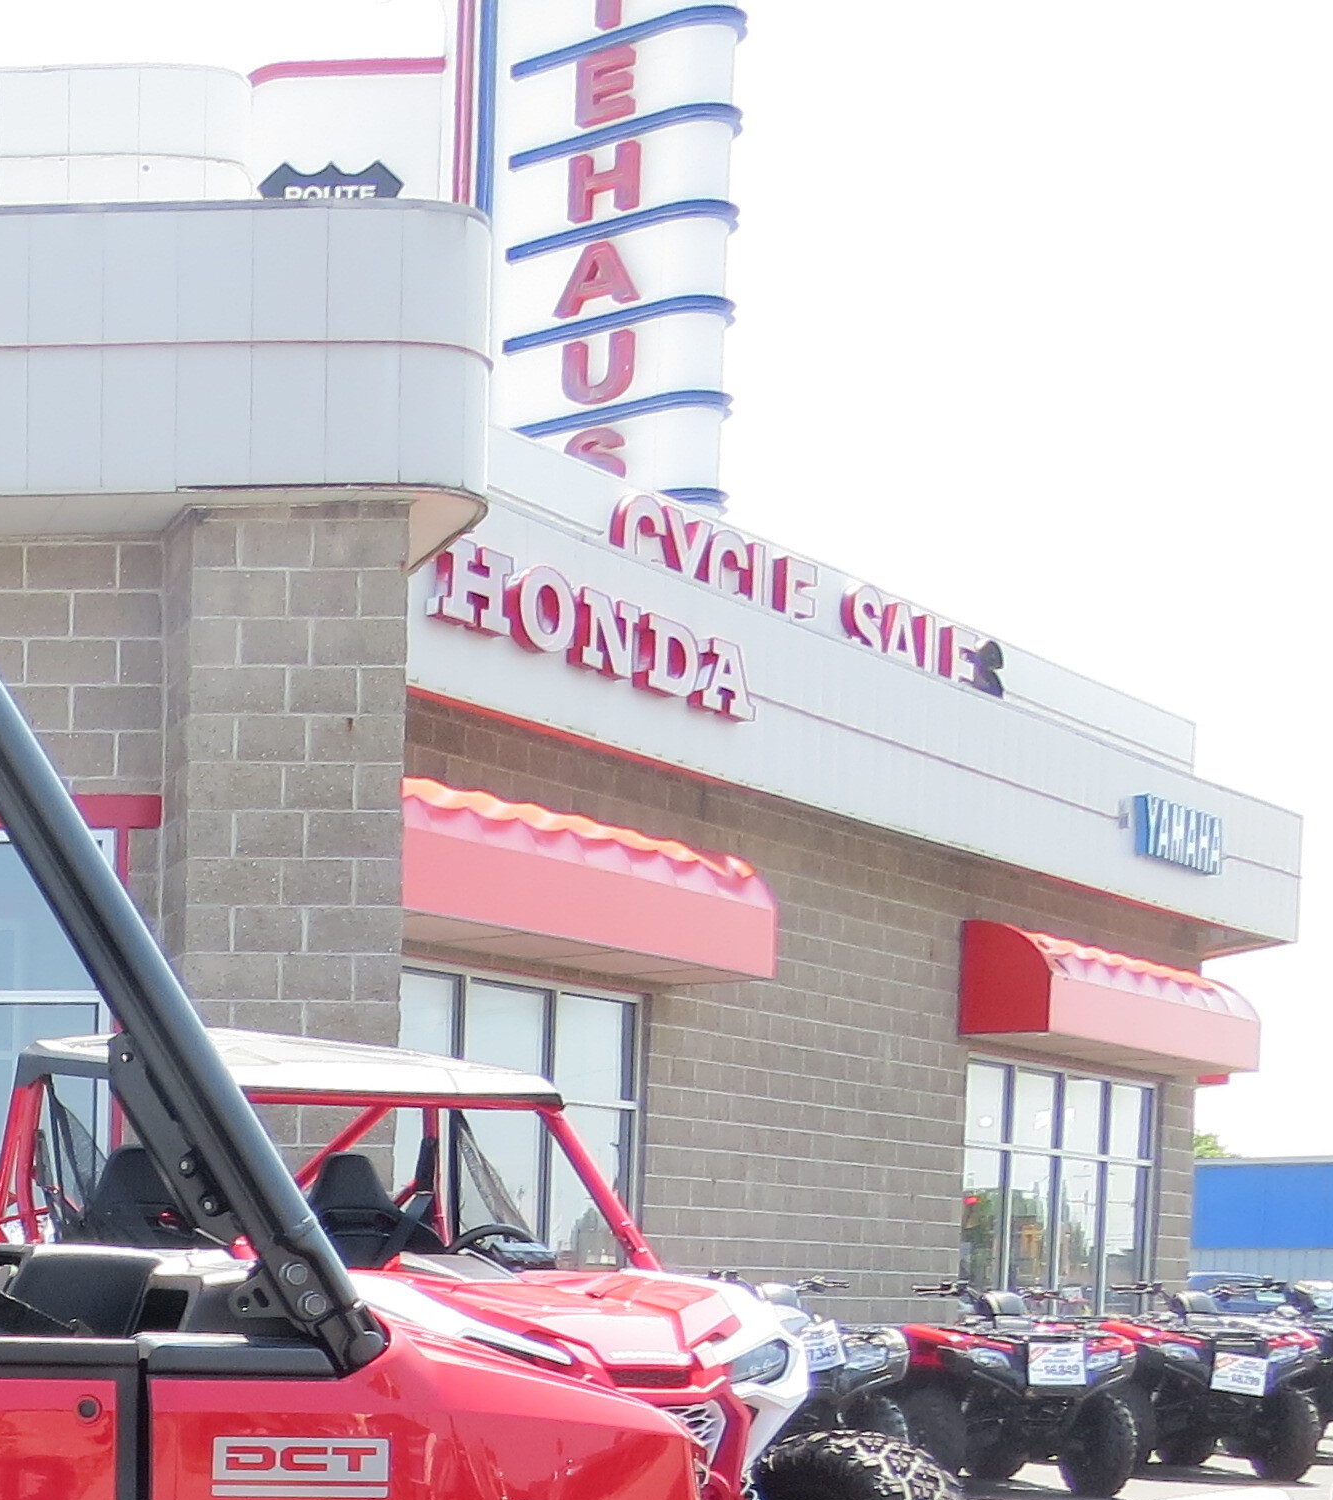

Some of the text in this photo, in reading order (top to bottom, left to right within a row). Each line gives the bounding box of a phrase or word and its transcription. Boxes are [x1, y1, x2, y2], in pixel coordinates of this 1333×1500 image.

[425, 538, 757, 723] HONDA
[1145, 793, 1223, 875] YAMAHA
[225, 1445, 377, 1473] DCT
